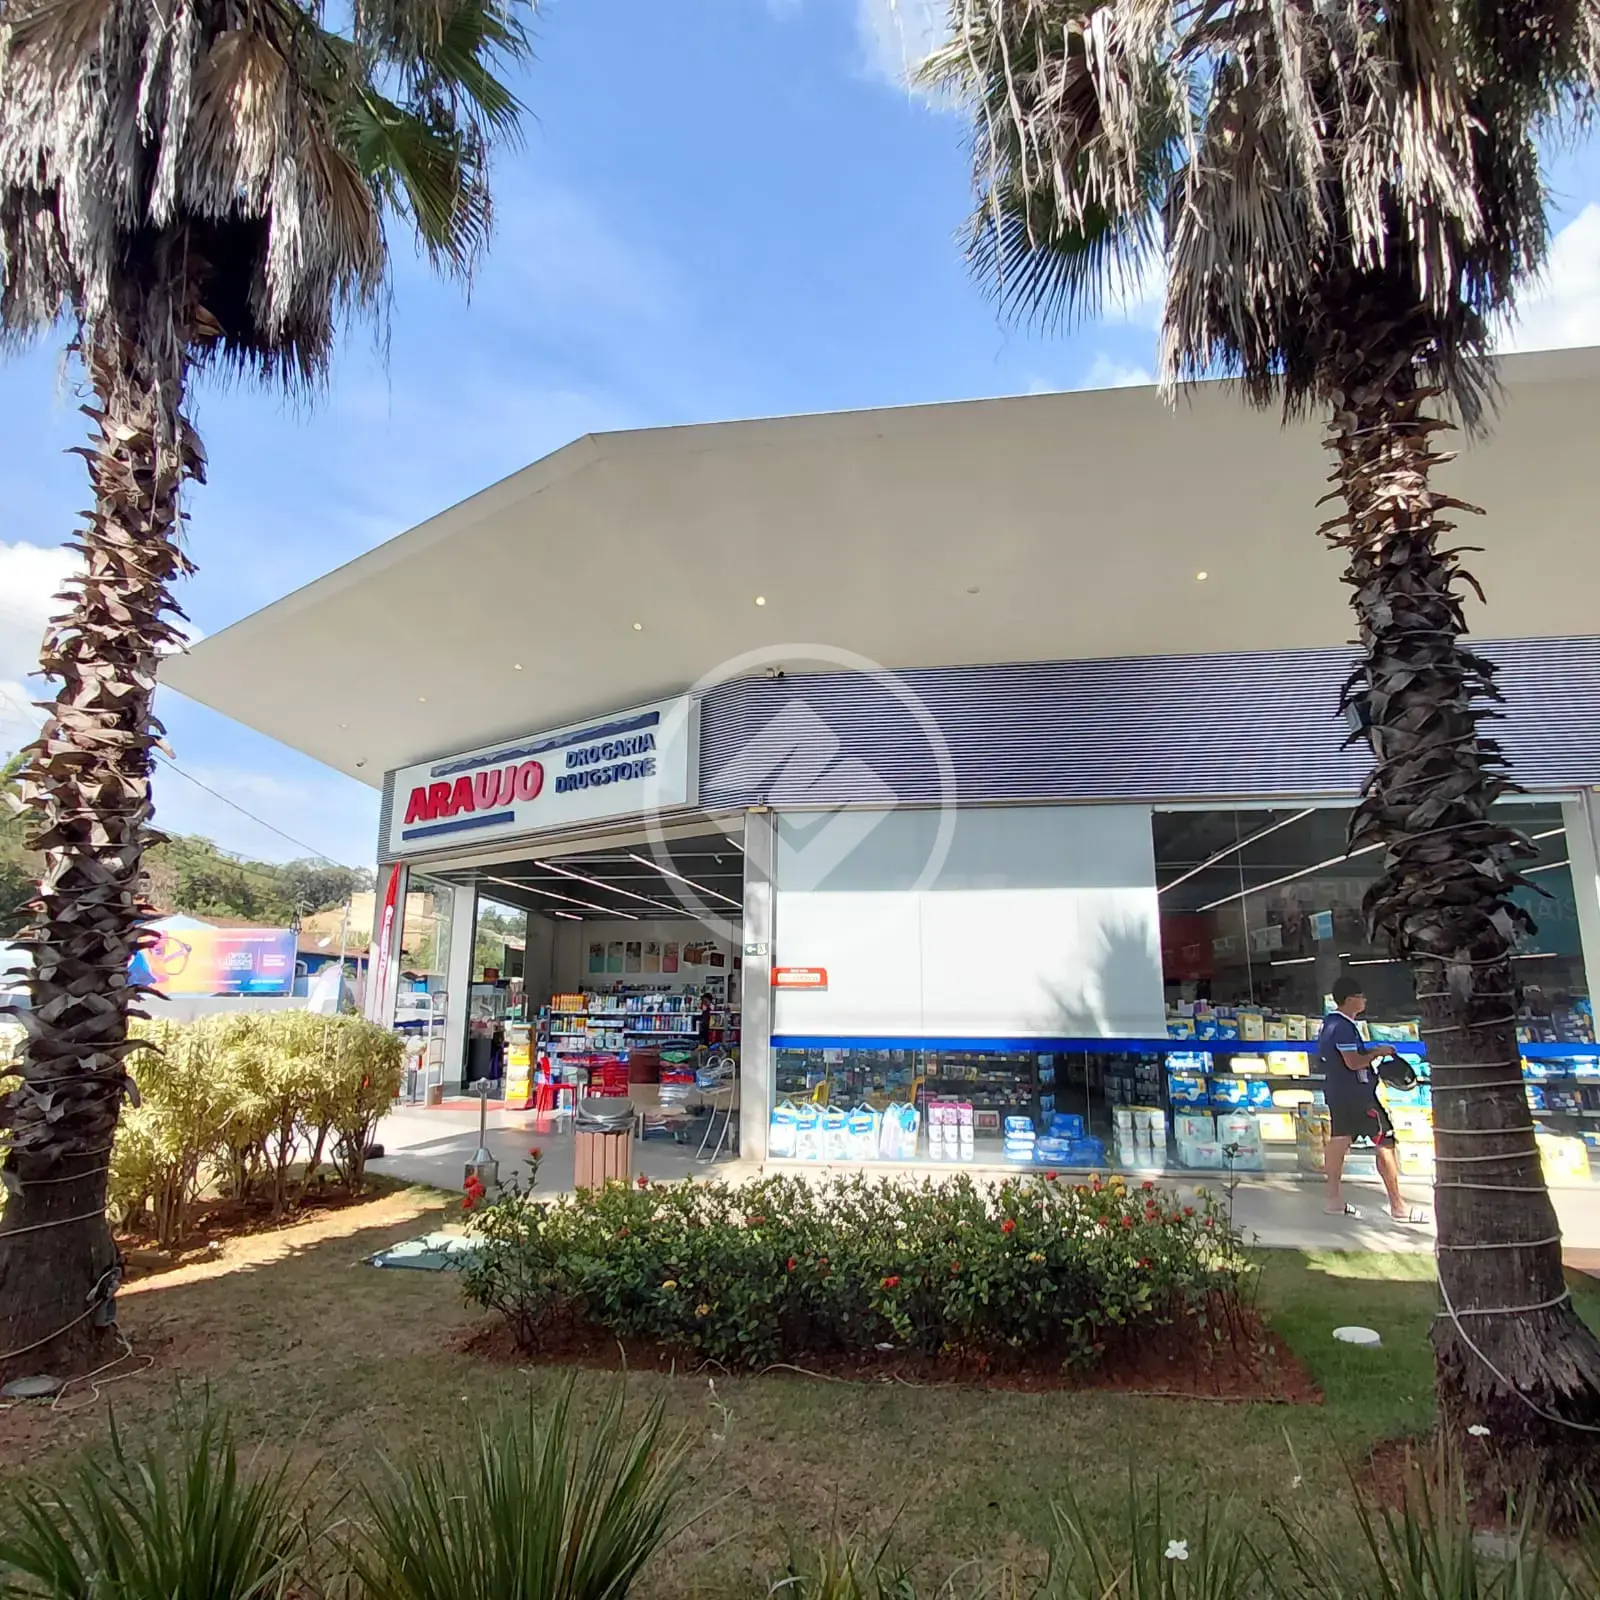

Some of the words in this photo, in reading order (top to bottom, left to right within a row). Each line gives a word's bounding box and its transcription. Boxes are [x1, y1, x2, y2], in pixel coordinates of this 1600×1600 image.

[566, 733, 656, 768] DROGARIA
[404, 760, 544, 824] ARAUJO
[555, 757, 656, 793] DRUGSTORE
